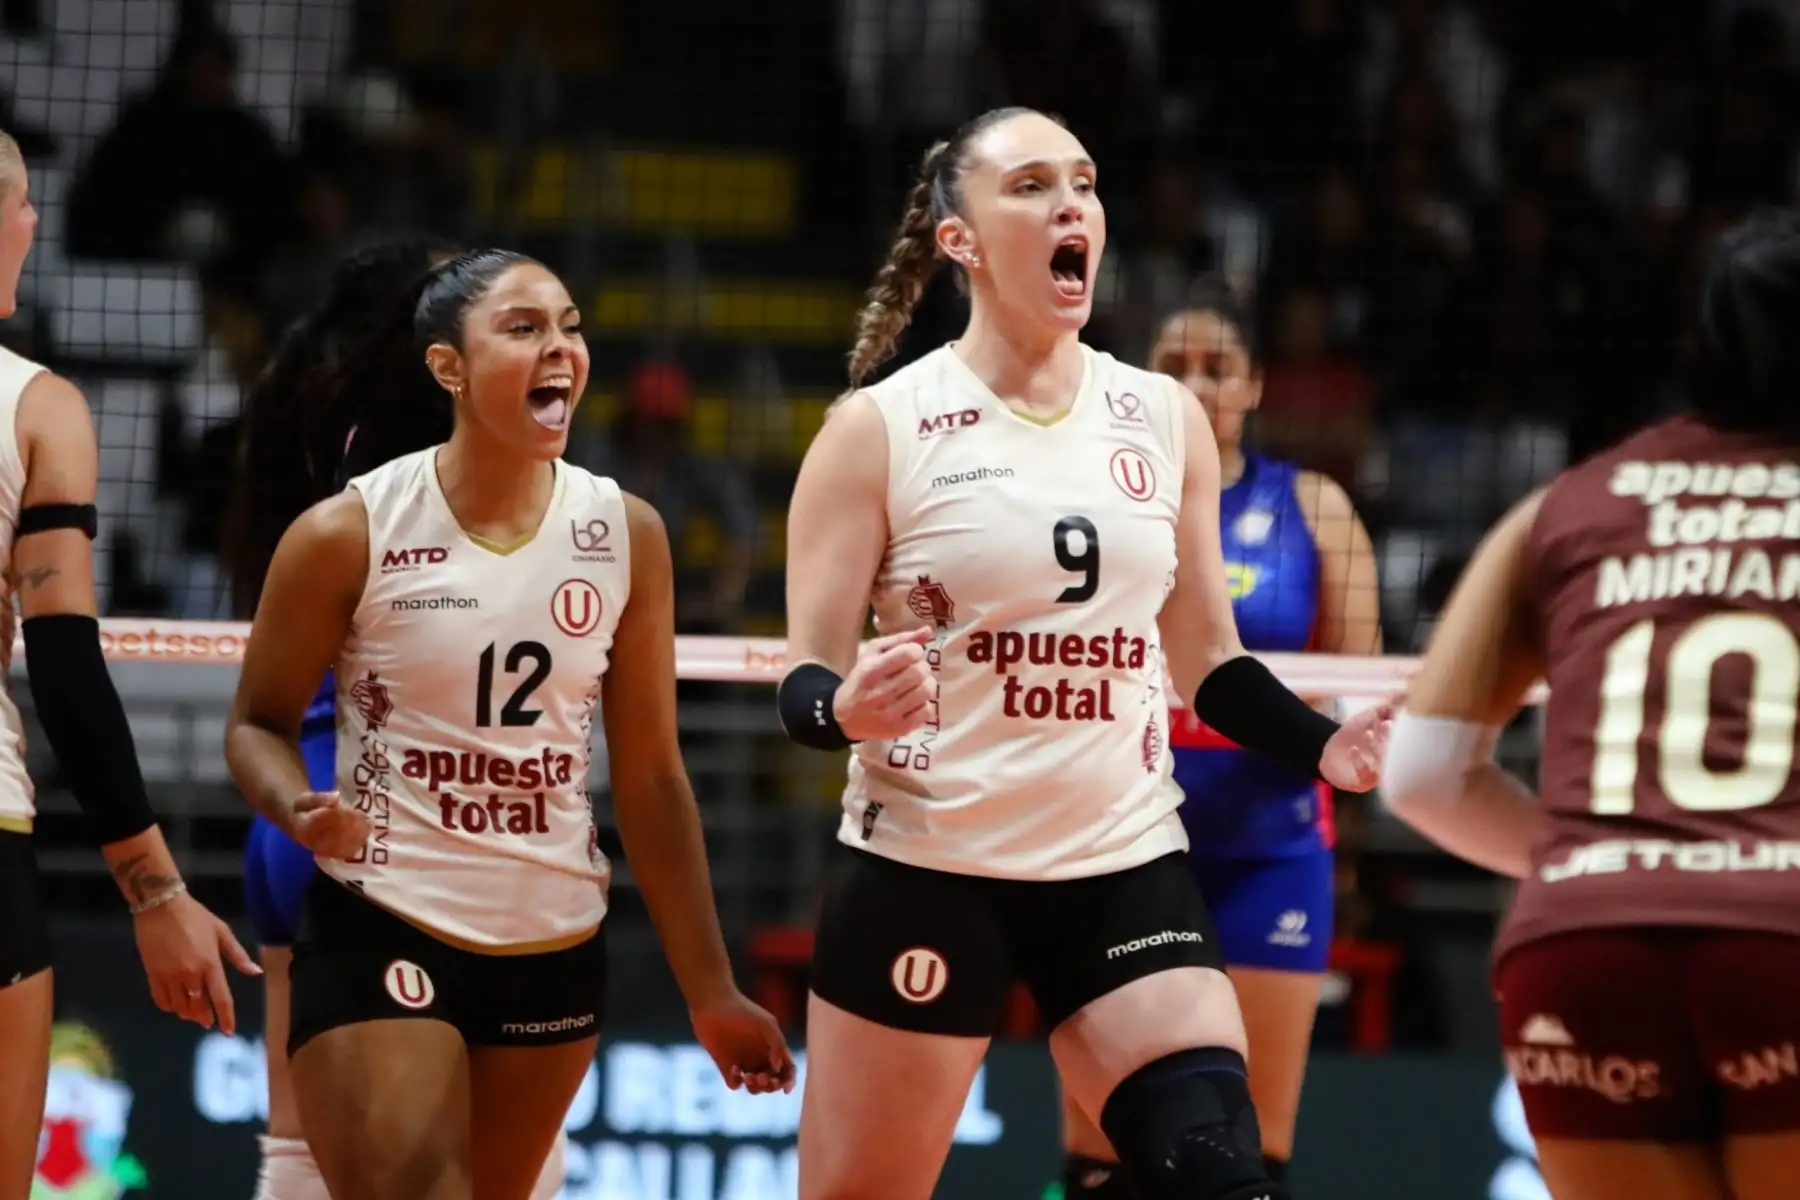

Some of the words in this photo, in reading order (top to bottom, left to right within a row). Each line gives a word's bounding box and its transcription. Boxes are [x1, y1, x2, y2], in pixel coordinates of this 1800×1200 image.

[918, 409, 980, 434] MTD
[932, 466, 1014, 488] marathon
[1120, 458, 1147, 495] U
[381, 547, 449, 567] MTD
[1053, 515, 1100, 604] 9
[392, 597, 479, 611] marathon
[563, 589, 591, 630] U
[966, 627, 1146, 674] apuesta
[475, 640, 552, 728] 12
[1003, 675, 1115, 722] total
[1590, 611, 1800, 815] 10
[401, 746, 573, 792] apuesta
[438, 792, 550, 835] total
[1107, 930, 1203, 959] marathon
[395, 967, 426, 1004] U
[904, 955, 938, 998] U
[503, 1013, 594, 1034] marathon
